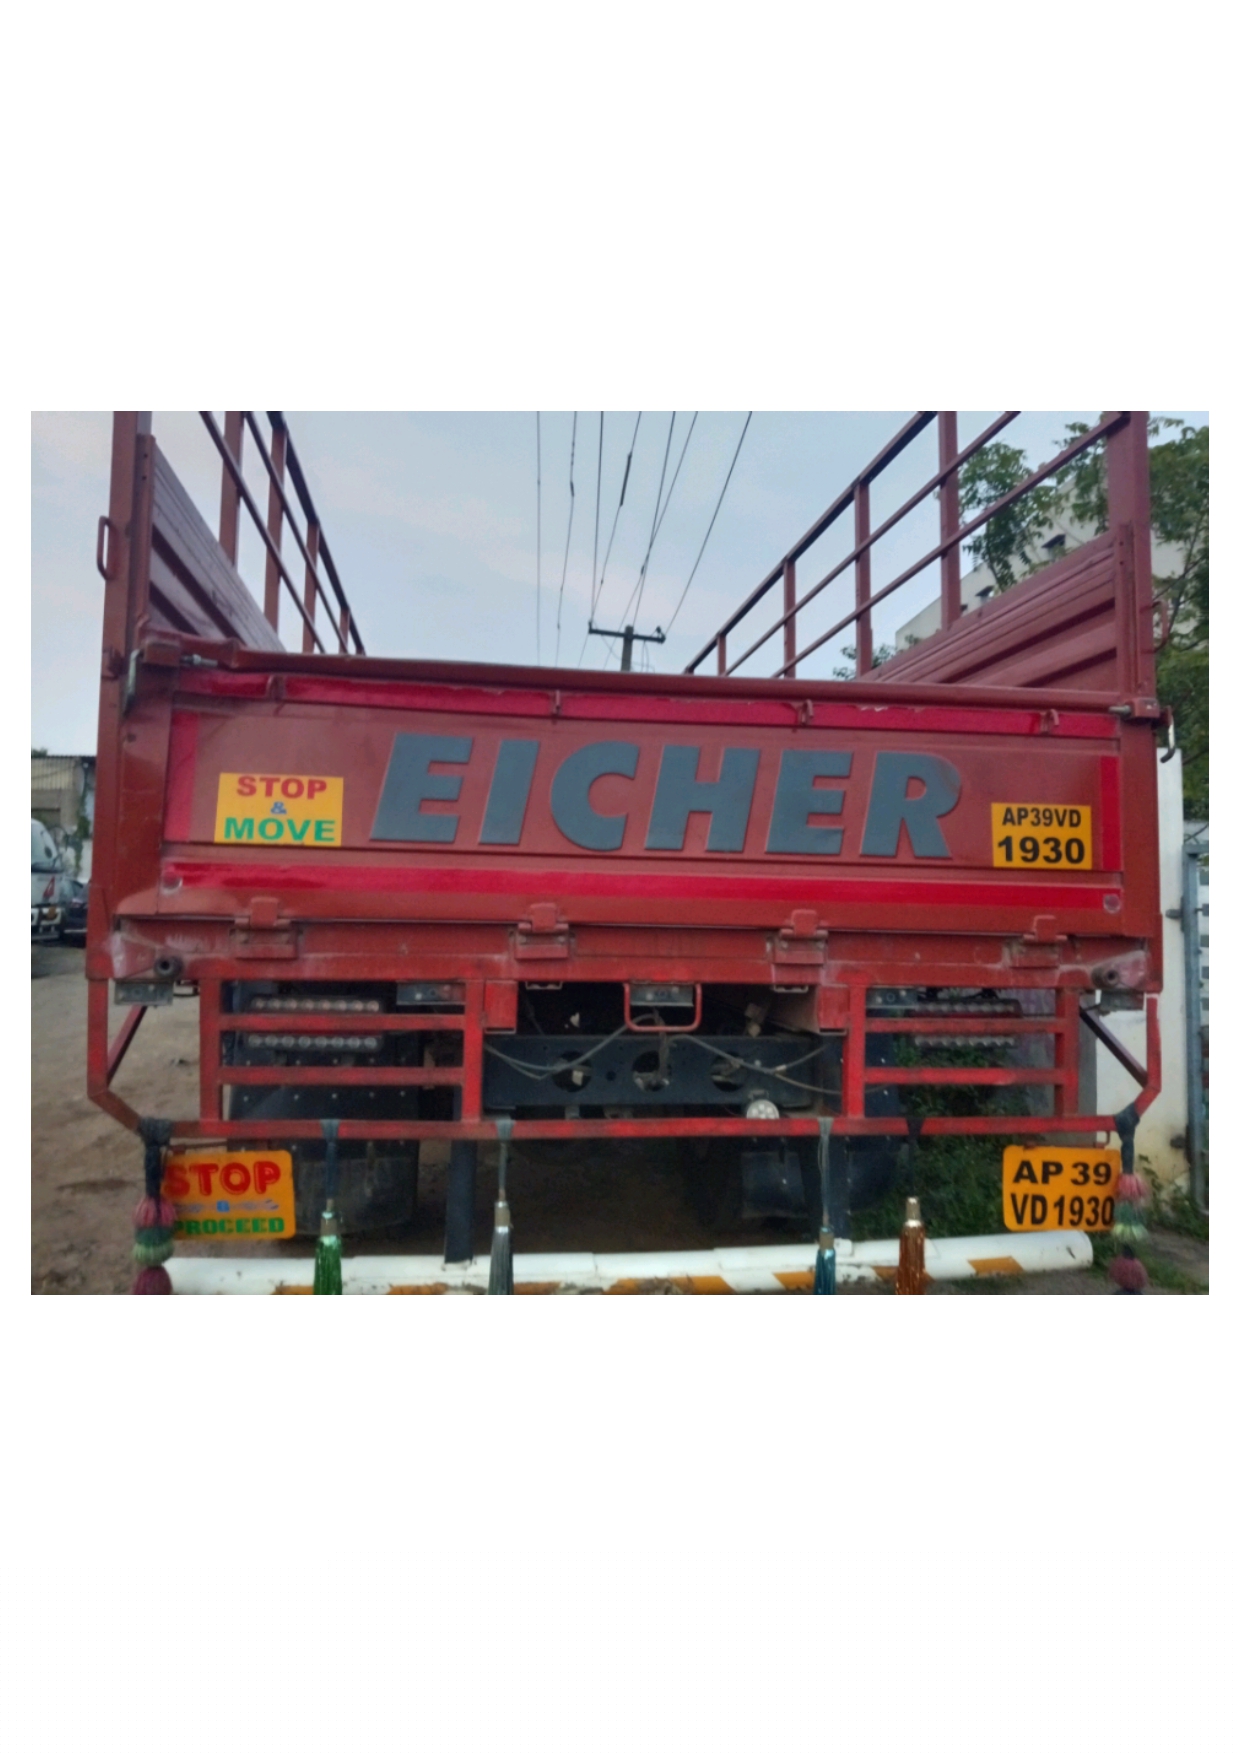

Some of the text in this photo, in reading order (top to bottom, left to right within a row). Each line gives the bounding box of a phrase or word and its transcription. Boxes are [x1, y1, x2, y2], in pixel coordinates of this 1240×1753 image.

[237, 775, 327, 800] STOP
[370, 732, 962, 860] EICHER
[270, 801, 287, 815] &
[1002, 807, 1082, 828] AP39VD
[224, 817, 335, 842] MOVE
[998, 836, 1085, 864] 1930
[164, 1161, 281, 1197] STOP
[1013, 1160, 1112, 1186] AP 39
